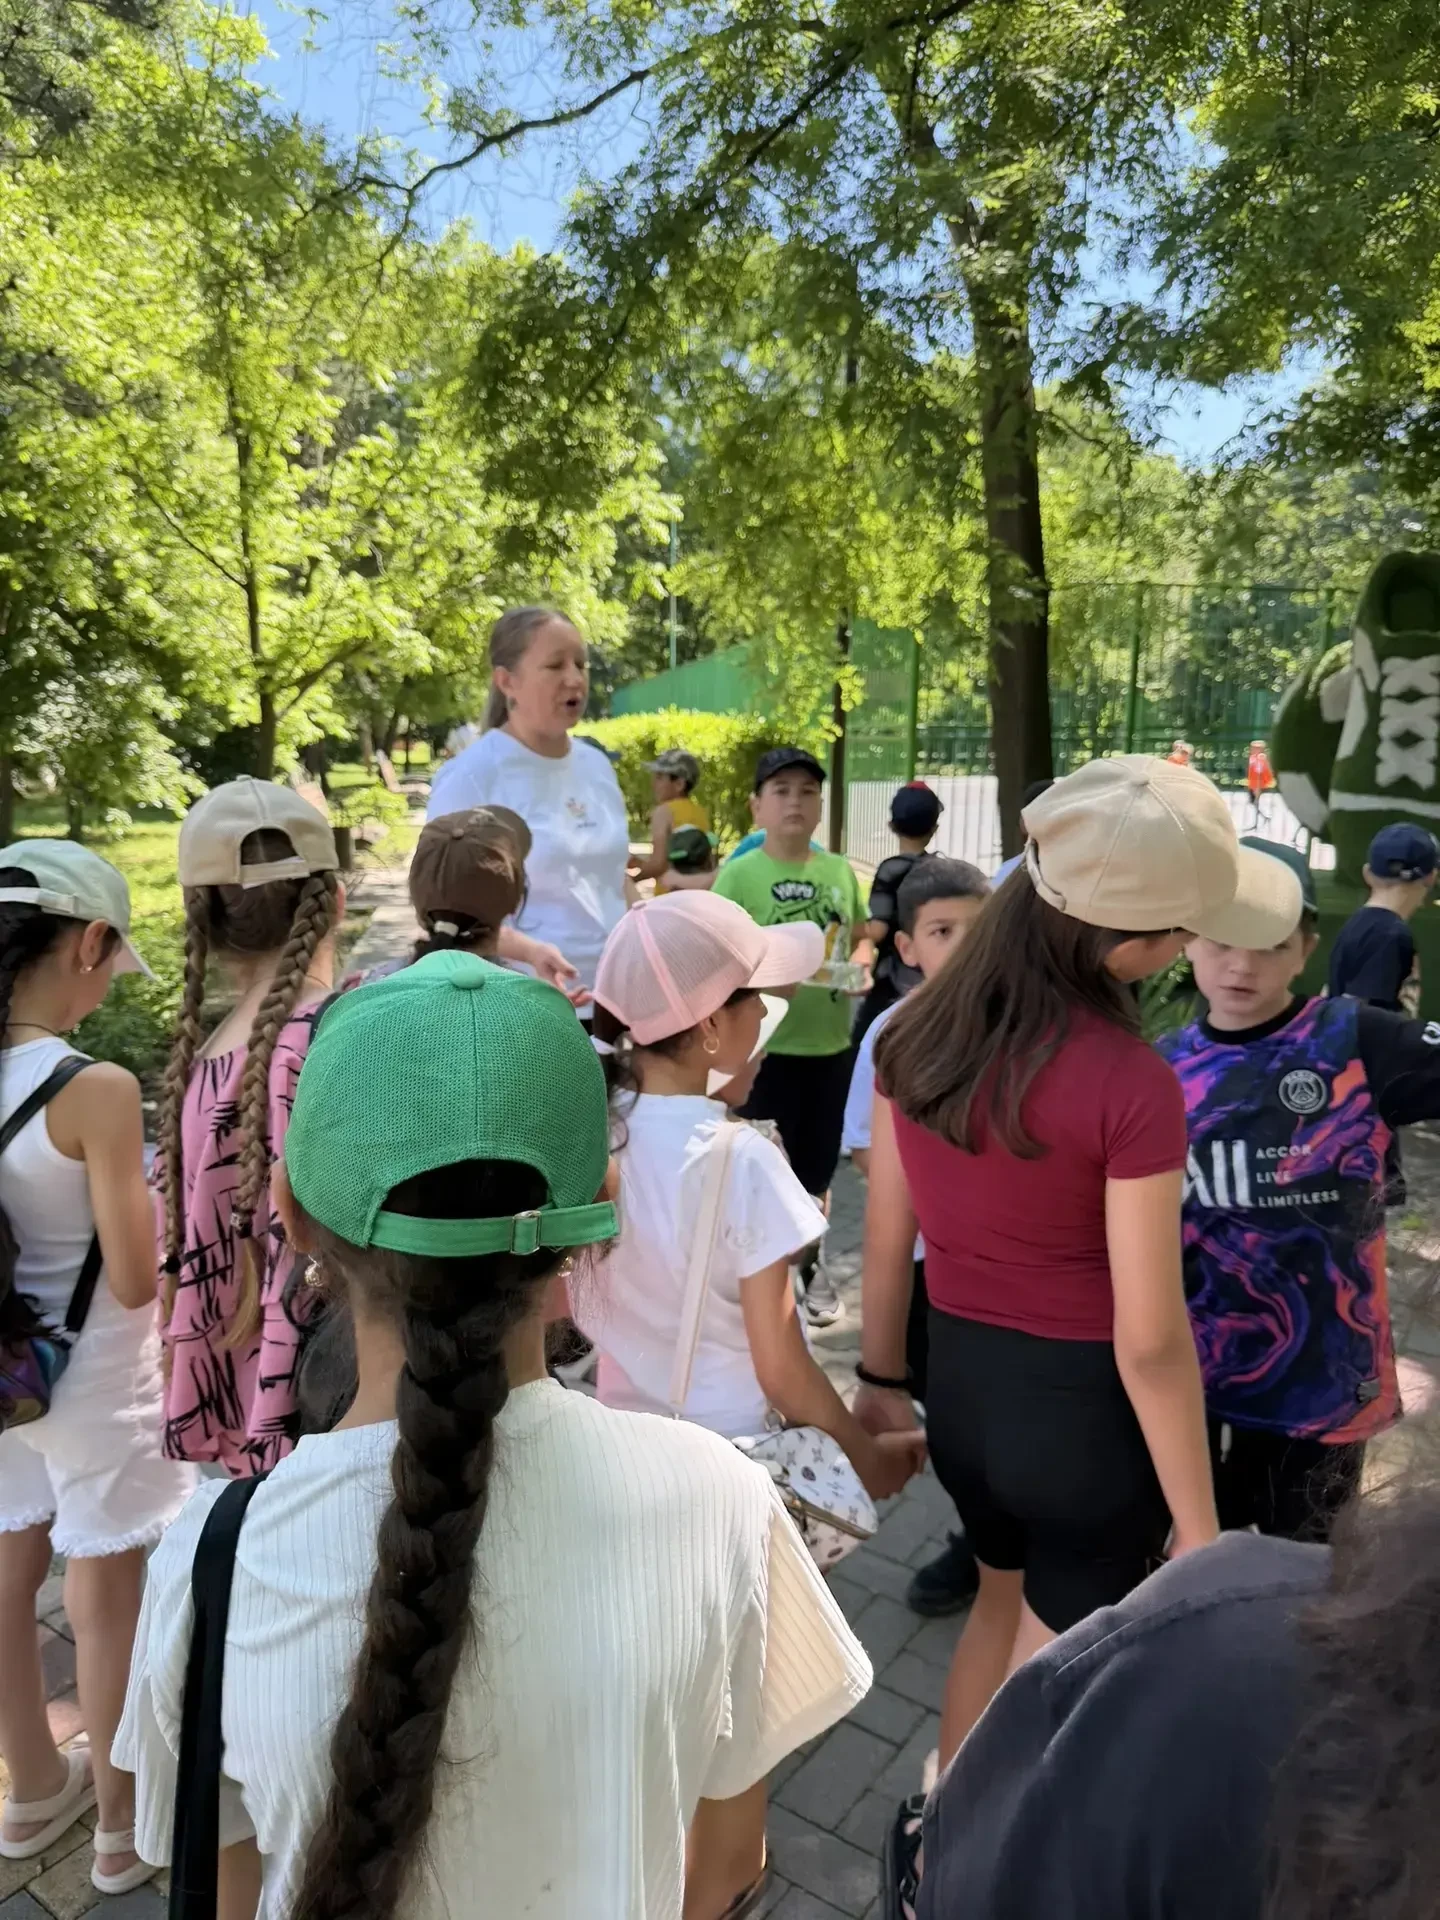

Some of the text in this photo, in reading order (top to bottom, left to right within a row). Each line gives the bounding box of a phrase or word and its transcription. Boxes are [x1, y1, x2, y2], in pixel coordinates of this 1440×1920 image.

[1256, 1144, 1312, 1159] ACCOR
[1256, 1171, 1293, 1184] LIVE
[1258, 1190, 1340, 1208] LIMITLESS
